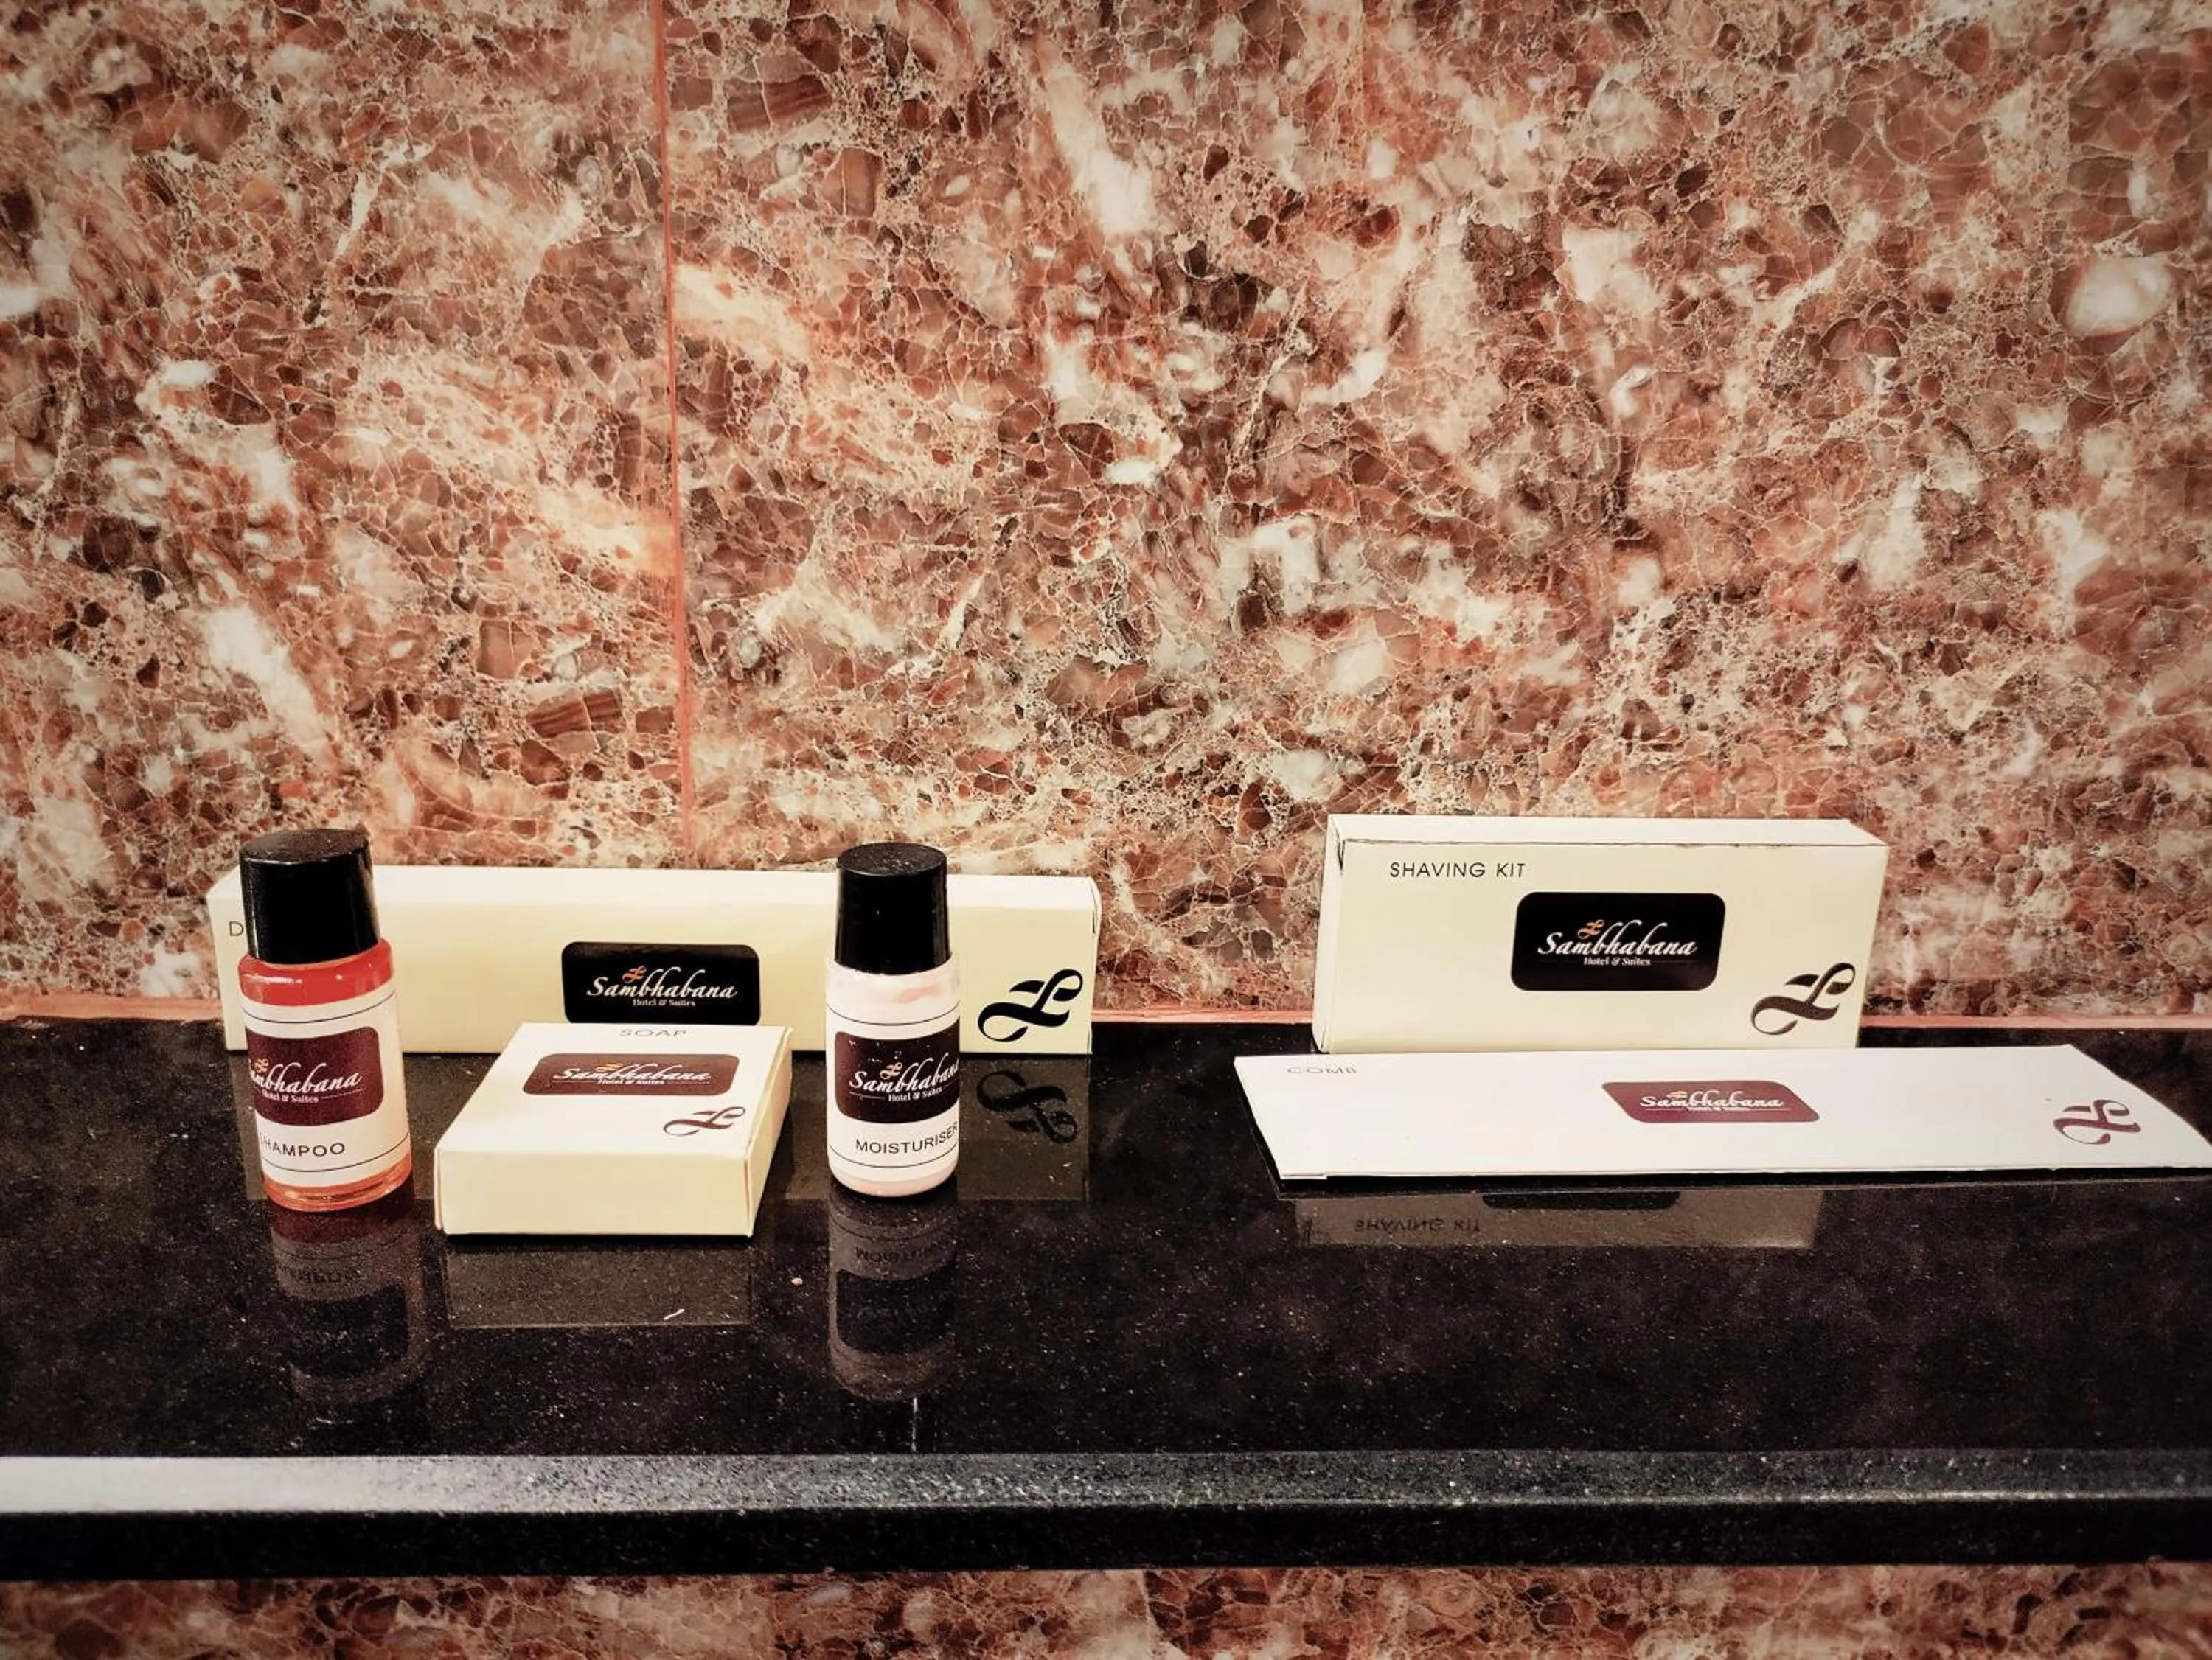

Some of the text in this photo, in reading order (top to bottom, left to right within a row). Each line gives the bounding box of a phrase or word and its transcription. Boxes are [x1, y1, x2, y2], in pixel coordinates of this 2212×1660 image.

[1389, 861, 1526, 879] SHAVING KIT
[1537, 918, 1698, 955] Sambhabana
[1583, 956, 1610, 966] Hotel
[1621, 957, 1652, 966] Suites
[586, 966, 738, 999] Sambhabana
[632, 997, 657, 1007] Hotel
[668, 998, 697, 1008] Suites
[619, 1028, 687, 1038] SOAP
[249, 1061, 363, 1094] ambhabana
[554, 1062, 712, 1081] Sambhabana
[888, 1092, 911, 1103] Hotel
[1639, 1089, 1785, 1108] Sambhabana
[855, 1120, 959, 1154] MOISTURISER
